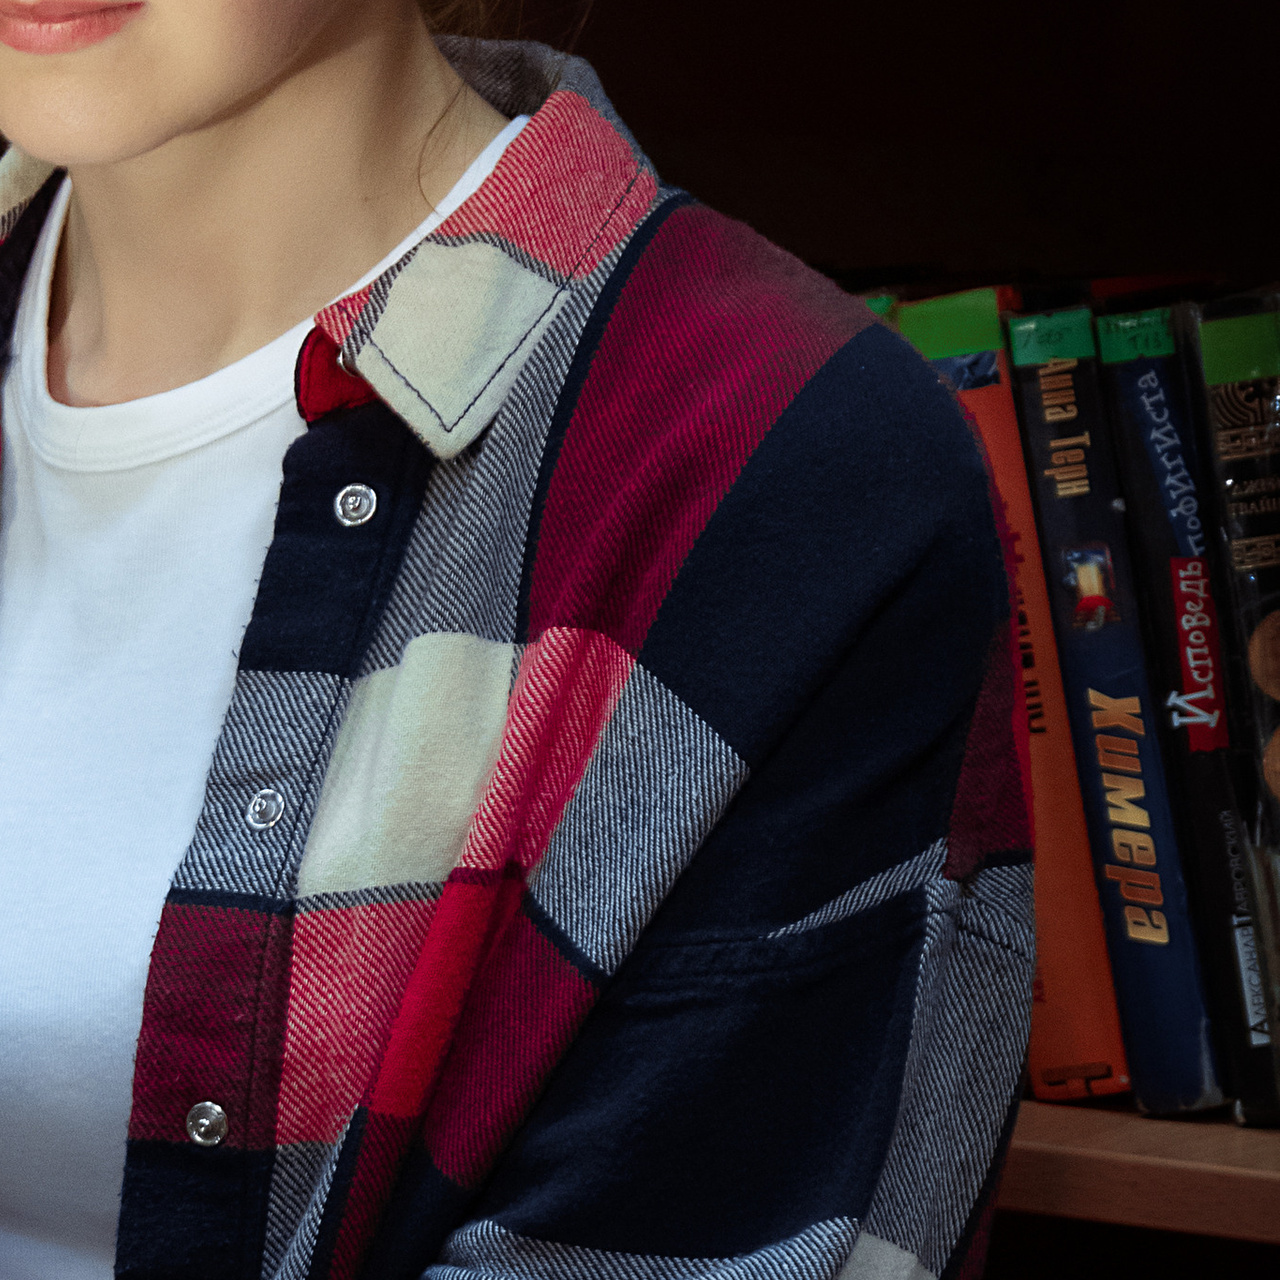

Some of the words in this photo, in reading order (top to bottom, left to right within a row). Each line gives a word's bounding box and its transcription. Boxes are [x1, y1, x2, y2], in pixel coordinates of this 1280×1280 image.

[1043, 431, 1092, 498] Терн
[1135, 368, 1206, 557] пофигиста
[1163, 558, 1221, 730] Исповедь
[1087, 686, 1173, 946] Химера
